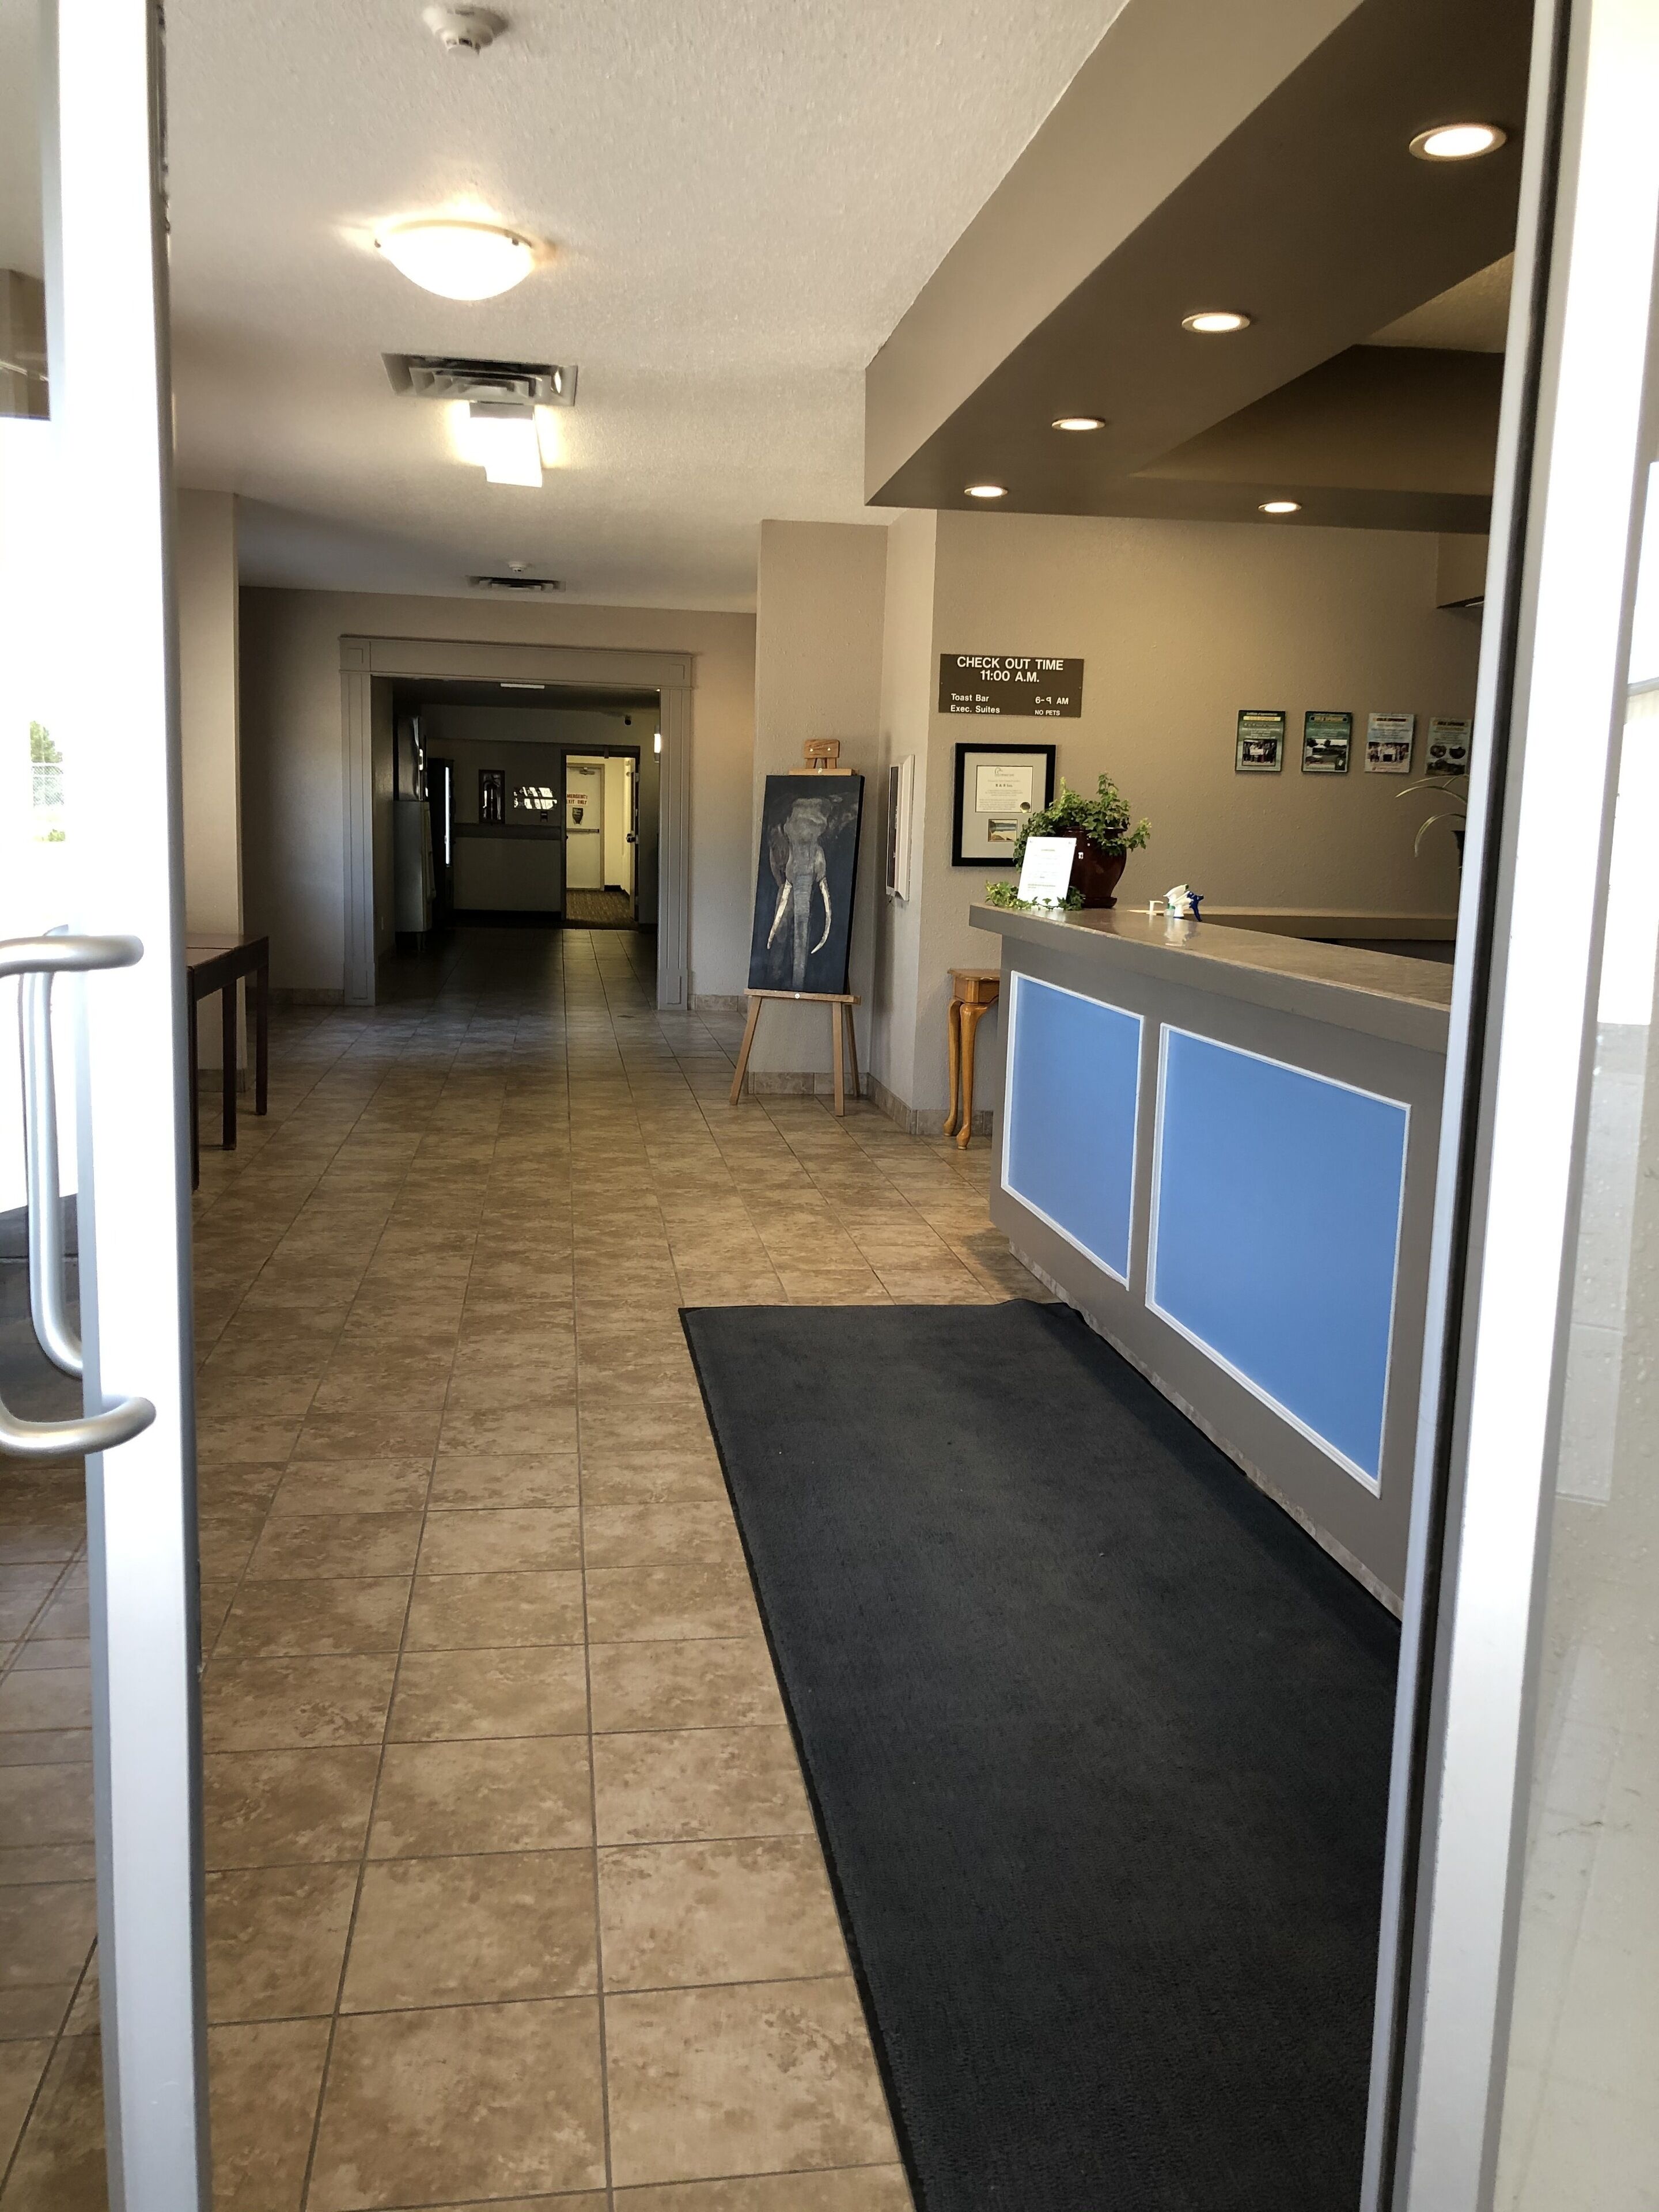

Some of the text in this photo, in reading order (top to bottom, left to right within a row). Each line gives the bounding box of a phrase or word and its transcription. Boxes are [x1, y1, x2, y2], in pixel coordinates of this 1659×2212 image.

[957, 656, 1064, 671] CHECK OUT TIME
[980, 670, 1040, 683] 11:00 A.M.
[951, 694, 972, 702] Toast
[975, 694, 990, 702] Bar
[975, 706, 1001, 714] Suites
